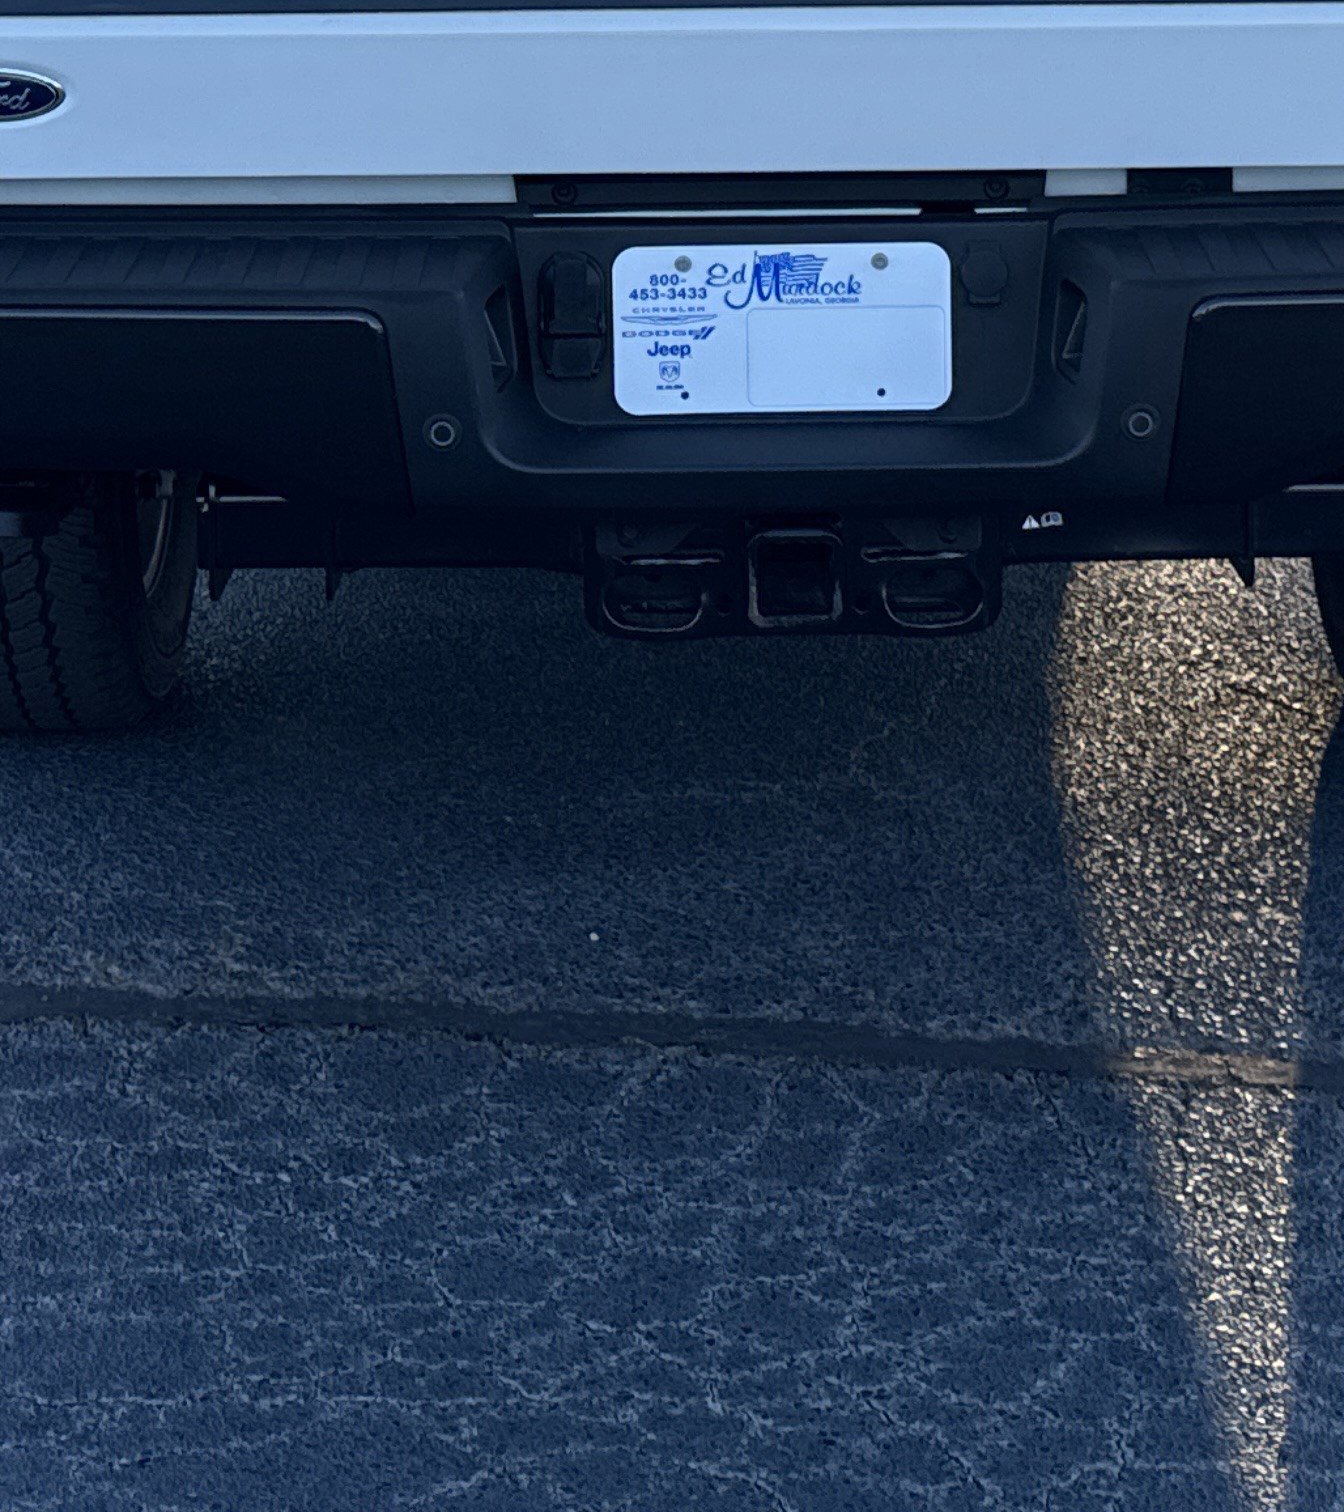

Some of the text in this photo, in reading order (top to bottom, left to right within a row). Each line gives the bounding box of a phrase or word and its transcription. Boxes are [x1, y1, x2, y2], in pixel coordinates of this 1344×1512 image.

[649, 274, 687, 287] 800-
[706, 257, 862, 310] Ed Murdock
[628, 286, 708, 301] 453-3433
[646, 340, 692, 359] Jeep
